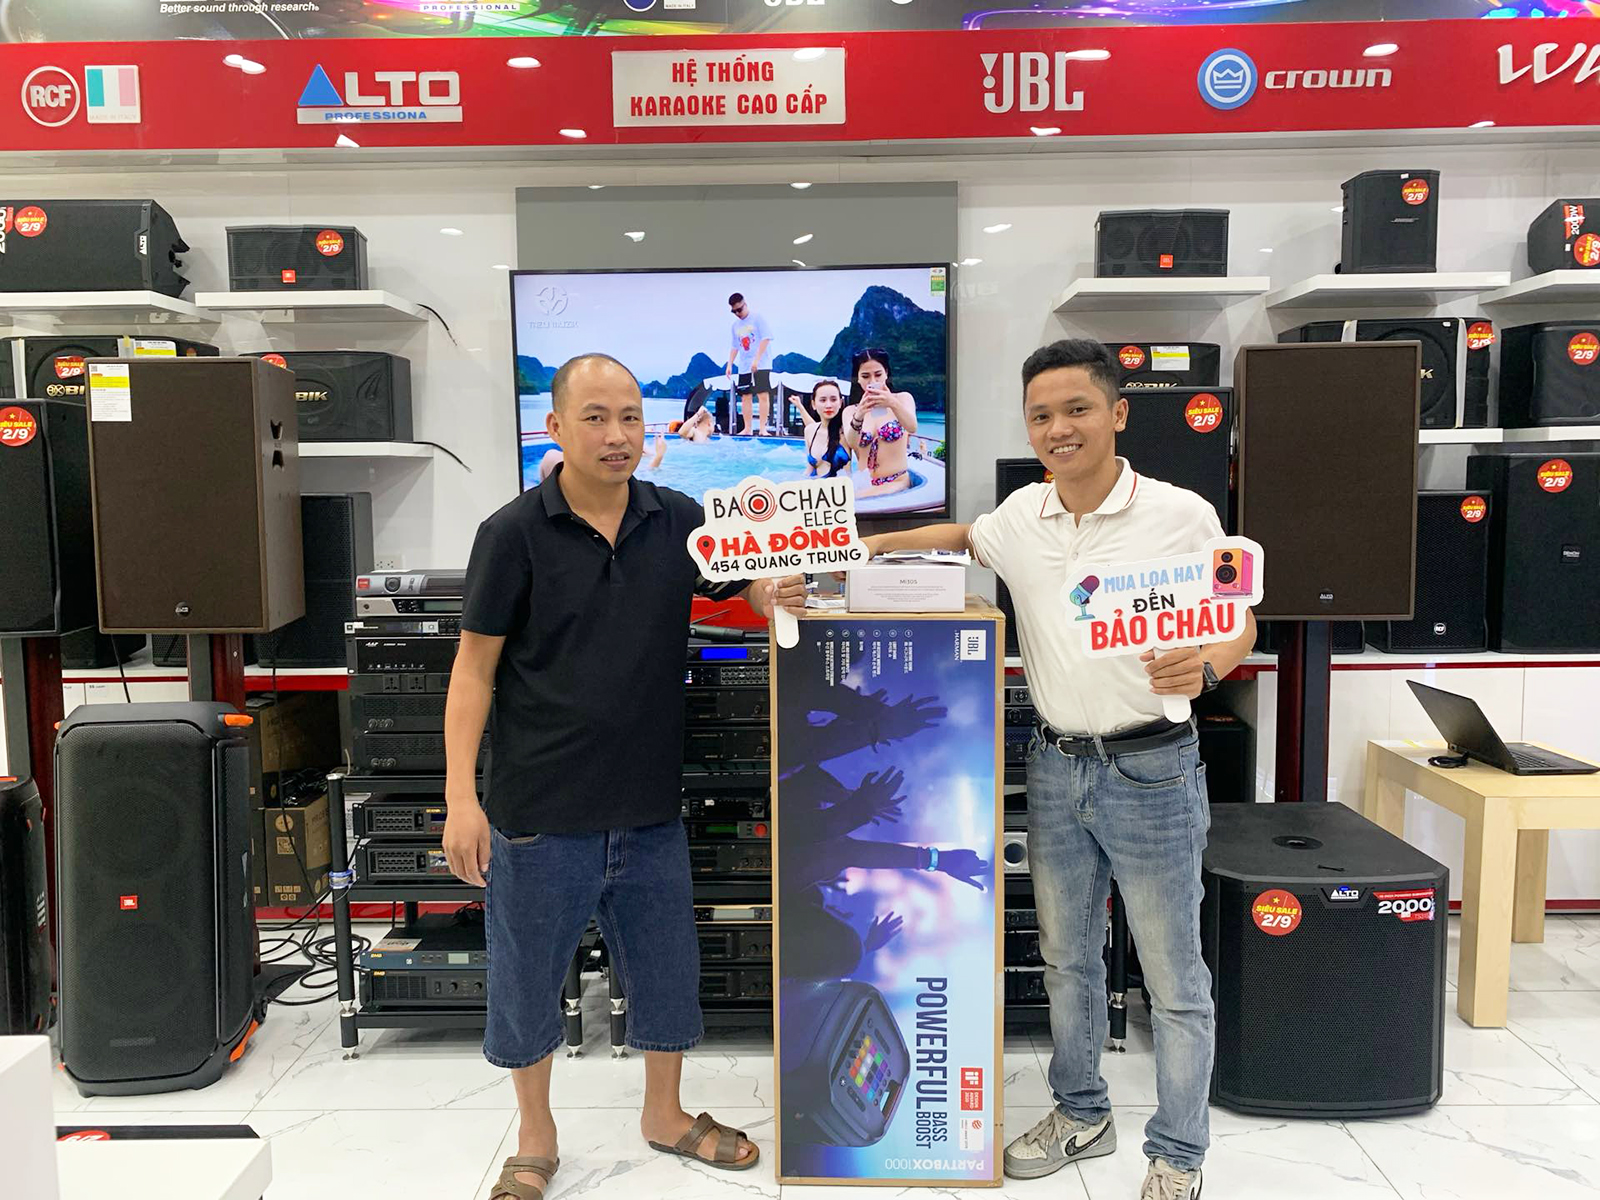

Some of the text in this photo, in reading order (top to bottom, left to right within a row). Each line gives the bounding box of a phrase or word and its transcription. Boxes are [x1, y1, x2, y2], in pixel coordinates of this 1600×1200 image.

[160, 3, 191, 13] Better
[194, 2, 226, 13] sound
[228, 1, 268, 14] through
[671, 54, 774, 87] HỆ THỐNG
[980, 51, 1085, 114] JBL
[1264, 68, 1392, 90] crown
[29, 84, 72, 108] RCF
[630, 83, 828, 116] KARAOKE CAO CẤP
[324, 111, 427, 121] PROFESSIONA
[1407, 192, 1424, 201] 2/9
[20, 222, 41, 232] 2/9
[322, 244, 339, 253] 2/9
[1123, 357, 1140, 365] 2/9
[1573, 350, 1593, 360] 2/9
[60, 367, 82, 377] 2/9
[295, 391, 328, 402] BIK
[1187, 406, 1220, 416] SIÊU SALE
[1193, 414, 1216, 427] 2/9
[2, 428, 29, 440] 2/9
[1544, 477, 1566, 488] 2/9
[713, 485, 847, 520] BAO CHAU
[804, 509, 847, 528] ELEC
[1465, 510, 1482, 518] 2/9
[720, 526, 850, 558] HÀ ĐÔNG
[711, 548, 862, 573] 454 QUANG TRUNG
[1103, 563, 1205, 594] MUA LOA HAY
[1132, 588, 1176, 613] ĐẾN
[1090, 598, 1235, 651] BẢO CHÂU
[967, 636, 979, 656] JBL
[1256, 904, 1298, 914] SIÊU SALE
[1261, 914, 1292, 928] 2/9
[916, 977, 948, 1110] POWERFUL
[915, 1111, 932, 1149] BOOST
[932, 1111, 948, 1142] BASS
